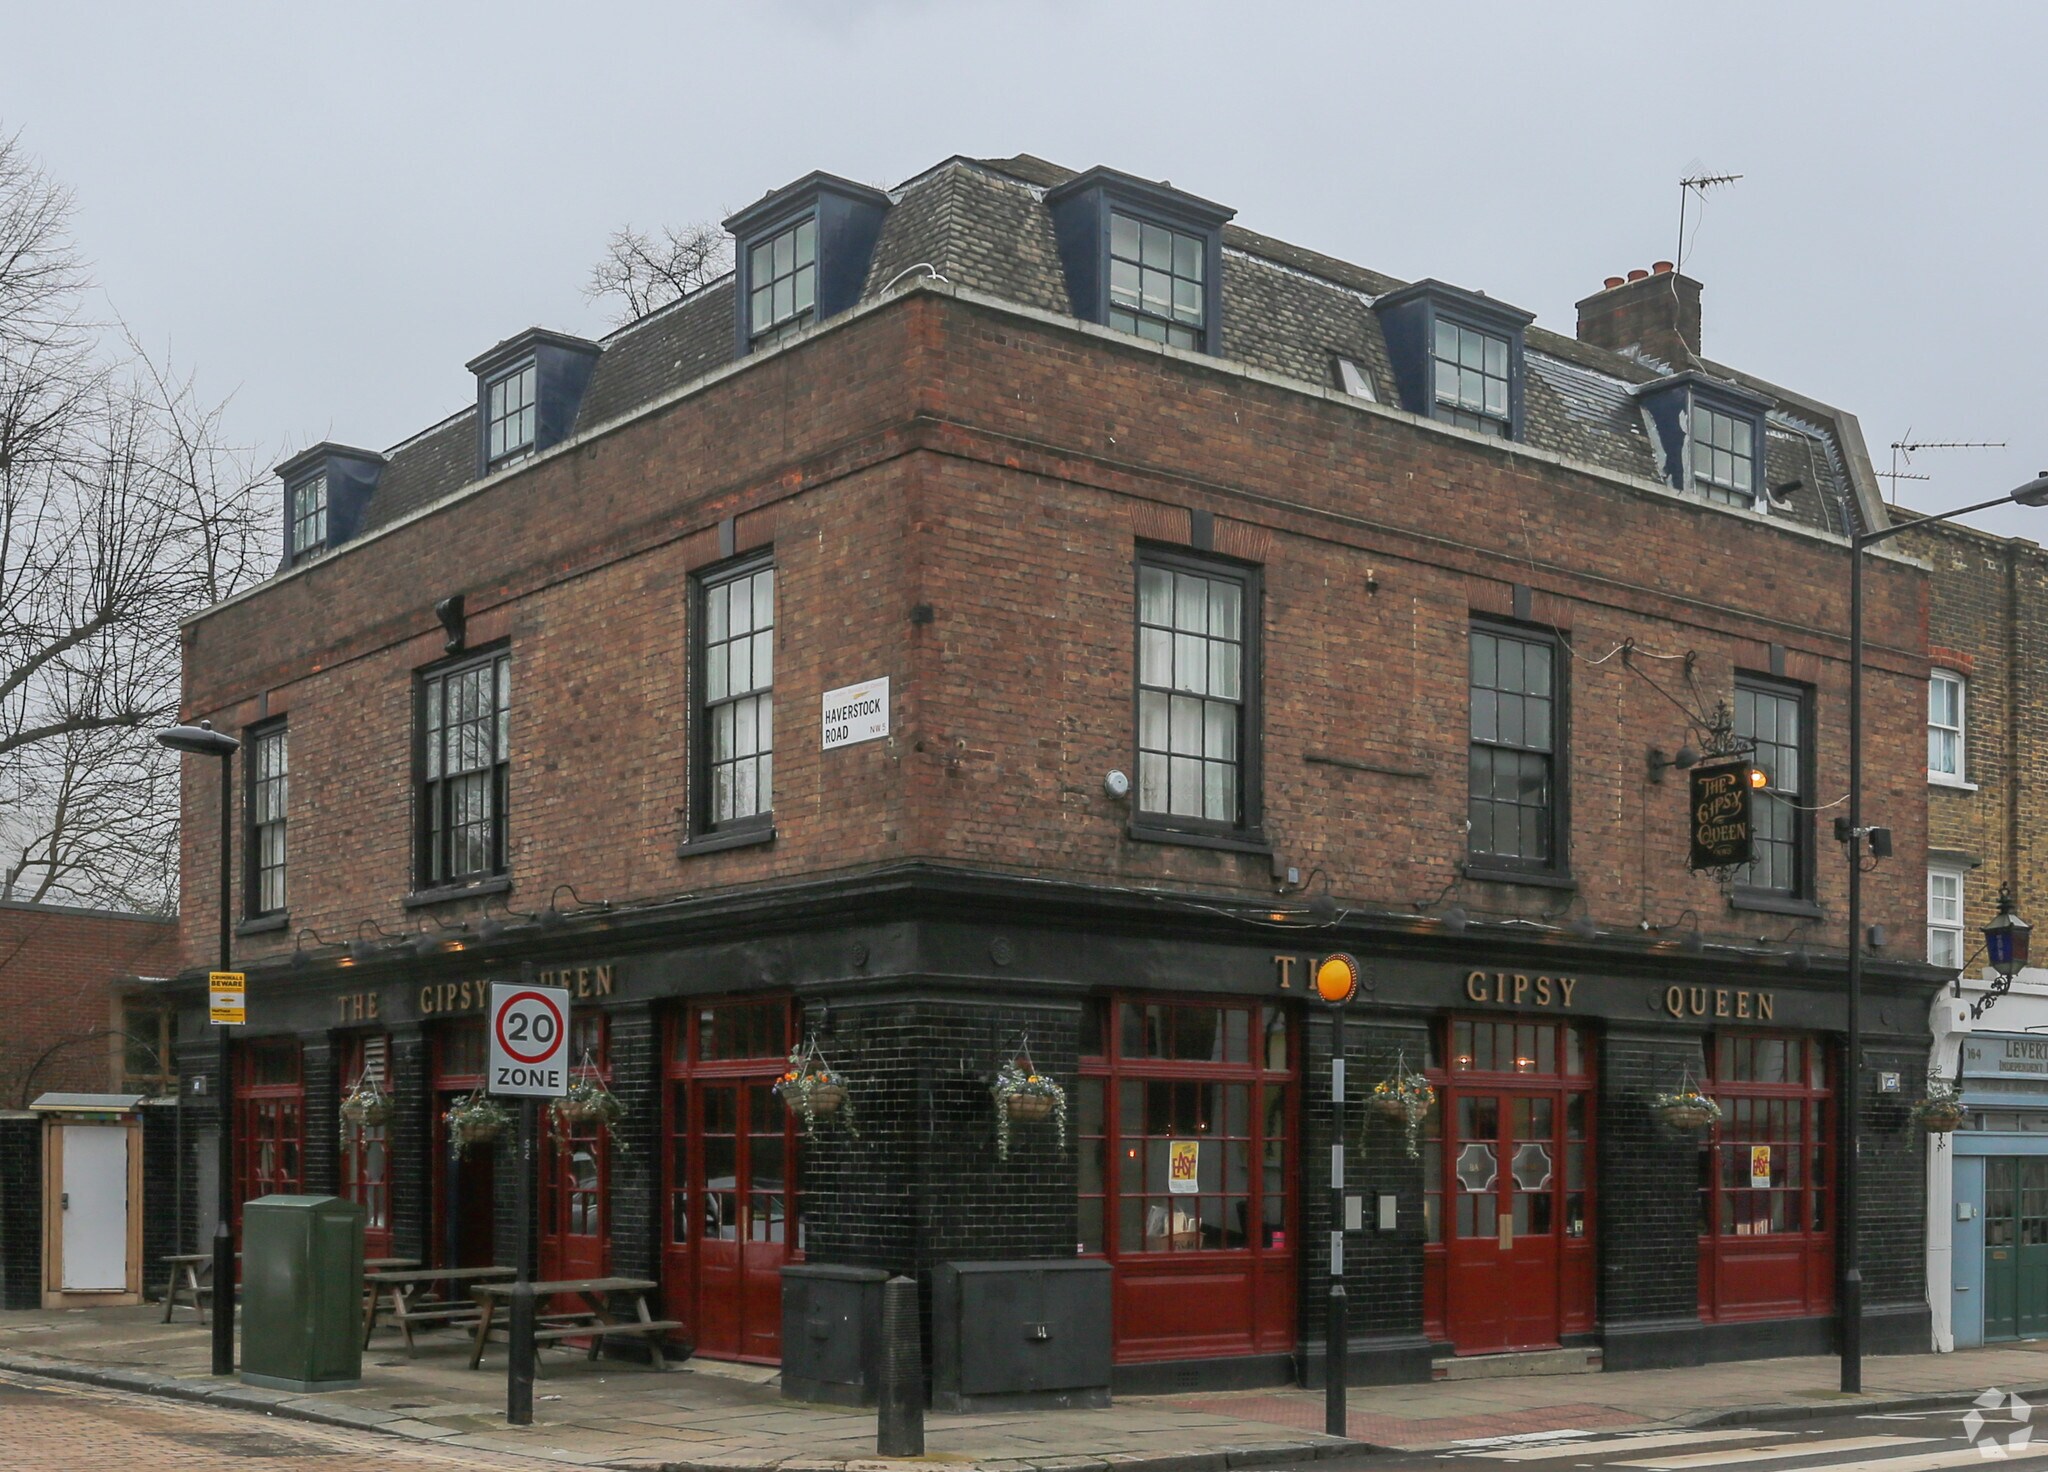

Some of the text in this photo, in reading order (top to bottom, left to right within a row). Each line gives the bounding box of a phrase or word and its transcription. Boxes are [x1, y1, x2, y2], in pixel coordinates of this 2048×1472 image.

[825, 698, 881, 724] HAVERSTOCK
[825, 725, 849, 743] ROAD
[1698, 774, 1736, 799] THE
[1696, 790, 1743, 824] GIPSY
[1696, 823, 1746, 849] QUEEN
[337, 965, 615, 1022] THE GIPSY EEN
[1467, 971, 1774, 1019] GIPSY QUEEN
[508, 1012, 554, 1043] 20
[1967, 1048, 1982, 1060] 164
[1999, 1060, 2043, 1073] INDEPENDENT
[498, 1067, 560, 1088] ZONE
